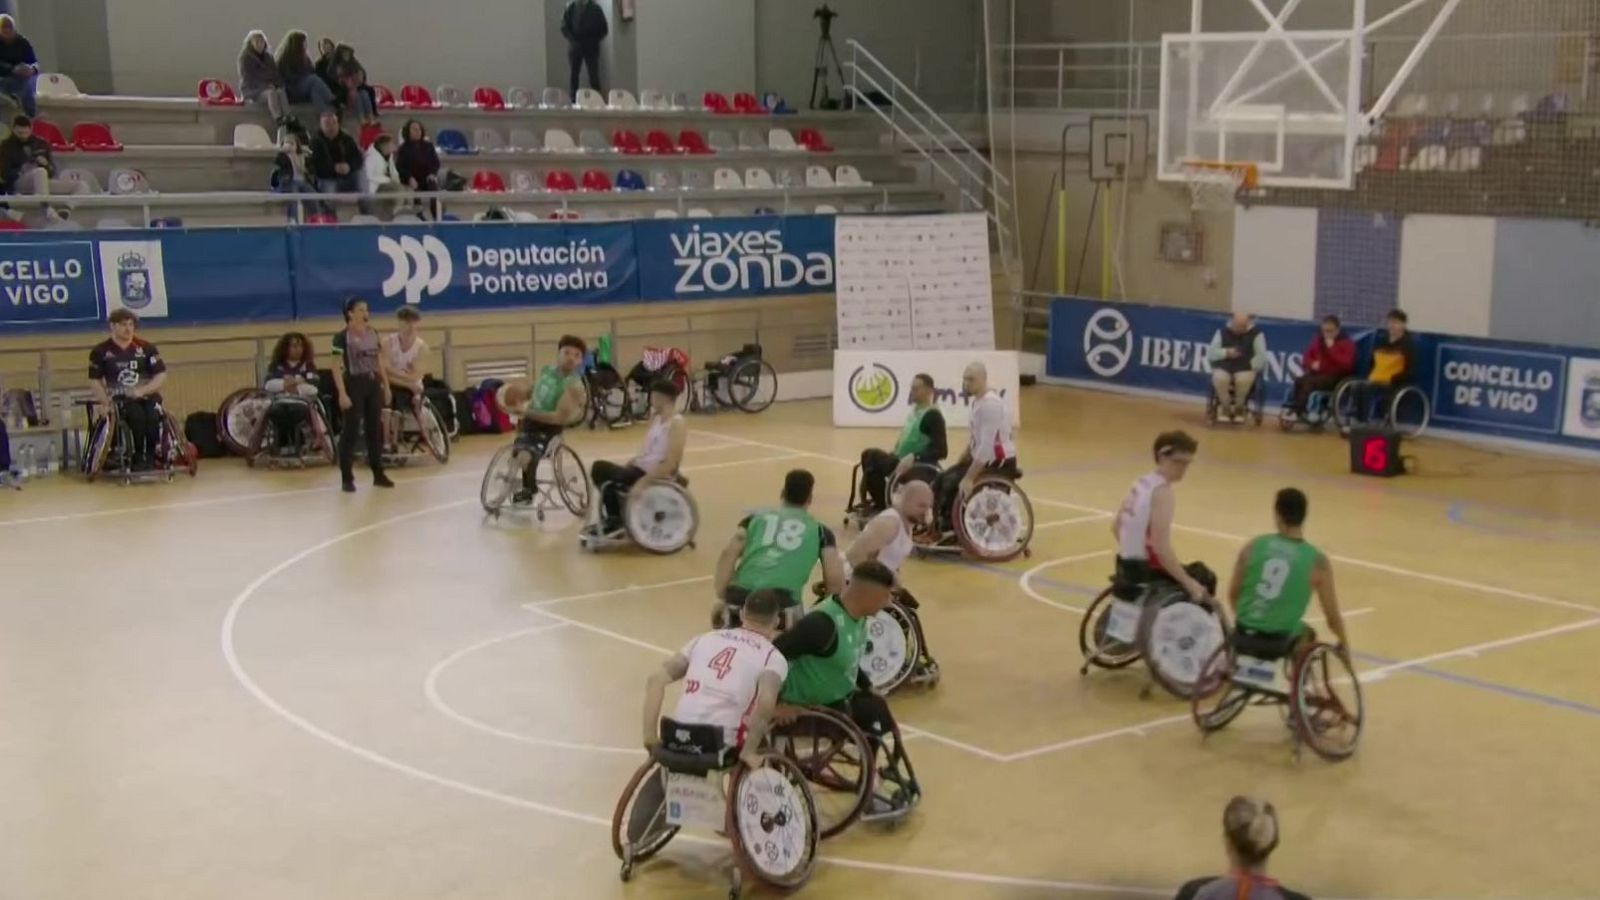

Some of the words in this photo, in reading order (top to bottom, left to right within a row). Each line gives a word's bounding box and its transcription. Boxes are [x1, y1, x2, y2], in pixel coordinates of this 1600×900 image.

[466, 239, 605, 271] Deputación
[670, 224, 783, 258] viaxes
[4, 284, 69, 305] VIGO
[469, 268, 608, 294] Pontevedra
[1444, 361, 1553, 391] CONCELLO
[1454, 385, 1481, 407] DE
[1488, 388, 1538, 413] VIGO
[1365, 438, 1386, 471] 6
[762, 513, 806, 551] 18
[1256, 558, 1290, 600] 9
[708, 646, 737, 680] 4
